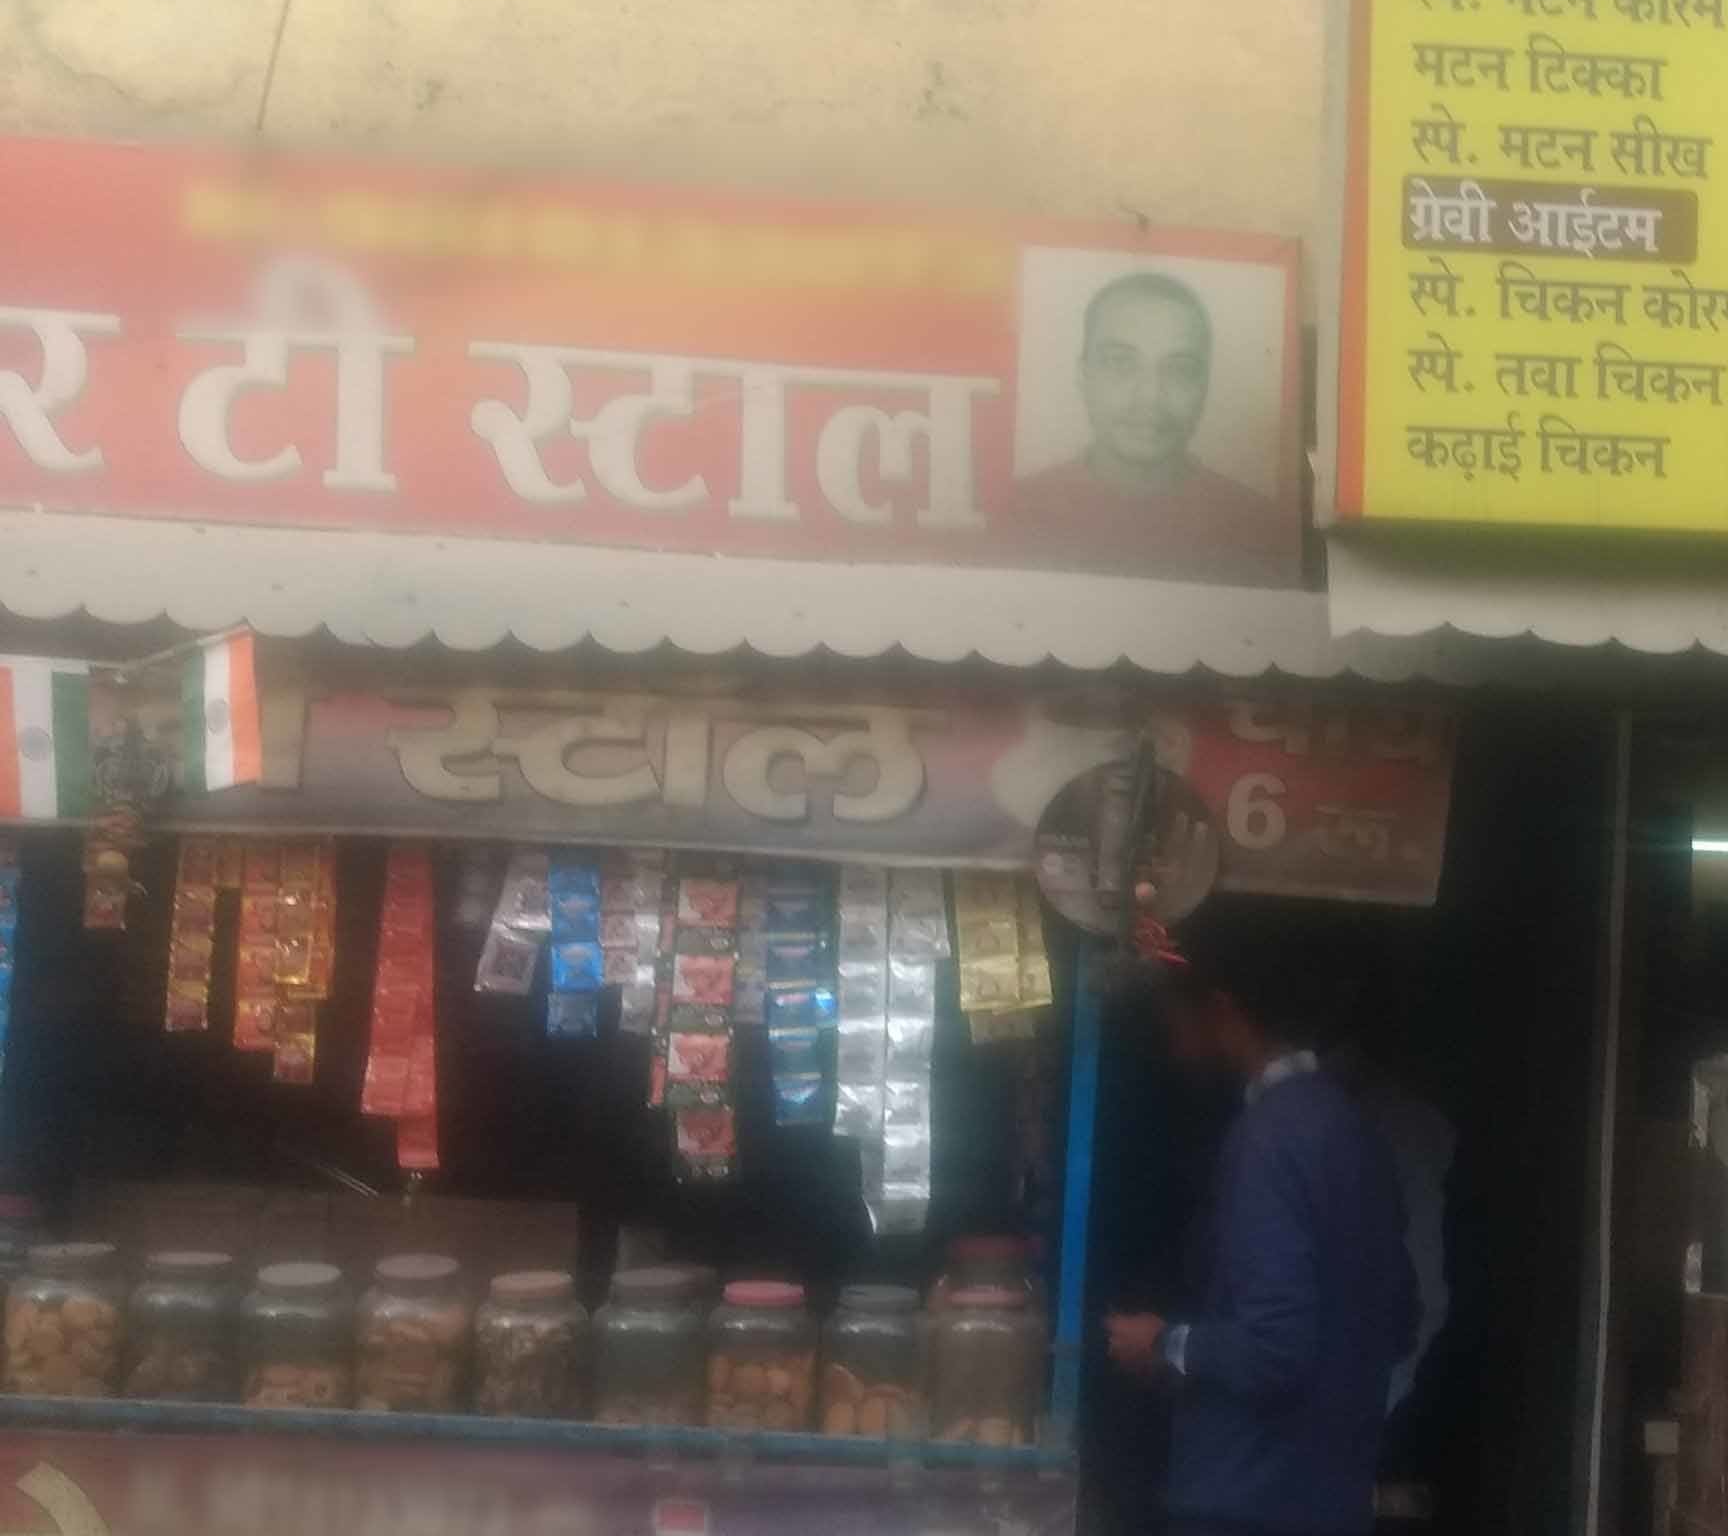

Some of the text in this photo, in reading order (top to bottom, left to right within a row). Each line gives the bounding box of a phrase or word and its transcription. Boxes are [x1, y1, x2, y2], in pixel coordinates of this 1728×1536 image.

[1413, 33, 1671, 103] मटन टिक्का
[1500, 124, 1597, 175] मटन
[1612, 119, 1714, 180] सीख
[1510, 188, 1664, 261] आईटम
[1498, 260, 1632, 326] चिकन
[177, 254, 414, 491] टी
[468, 337, 1000, 530] स्टाल
[1495, 352, 1583, 401] तवा
[1596, 341, 1728, 407] चिकन
[1537, 414, 1673, 480] चिकन
[387, 682, 955, 825] स्टाल
[1226, 772, 1288, 851] 6
